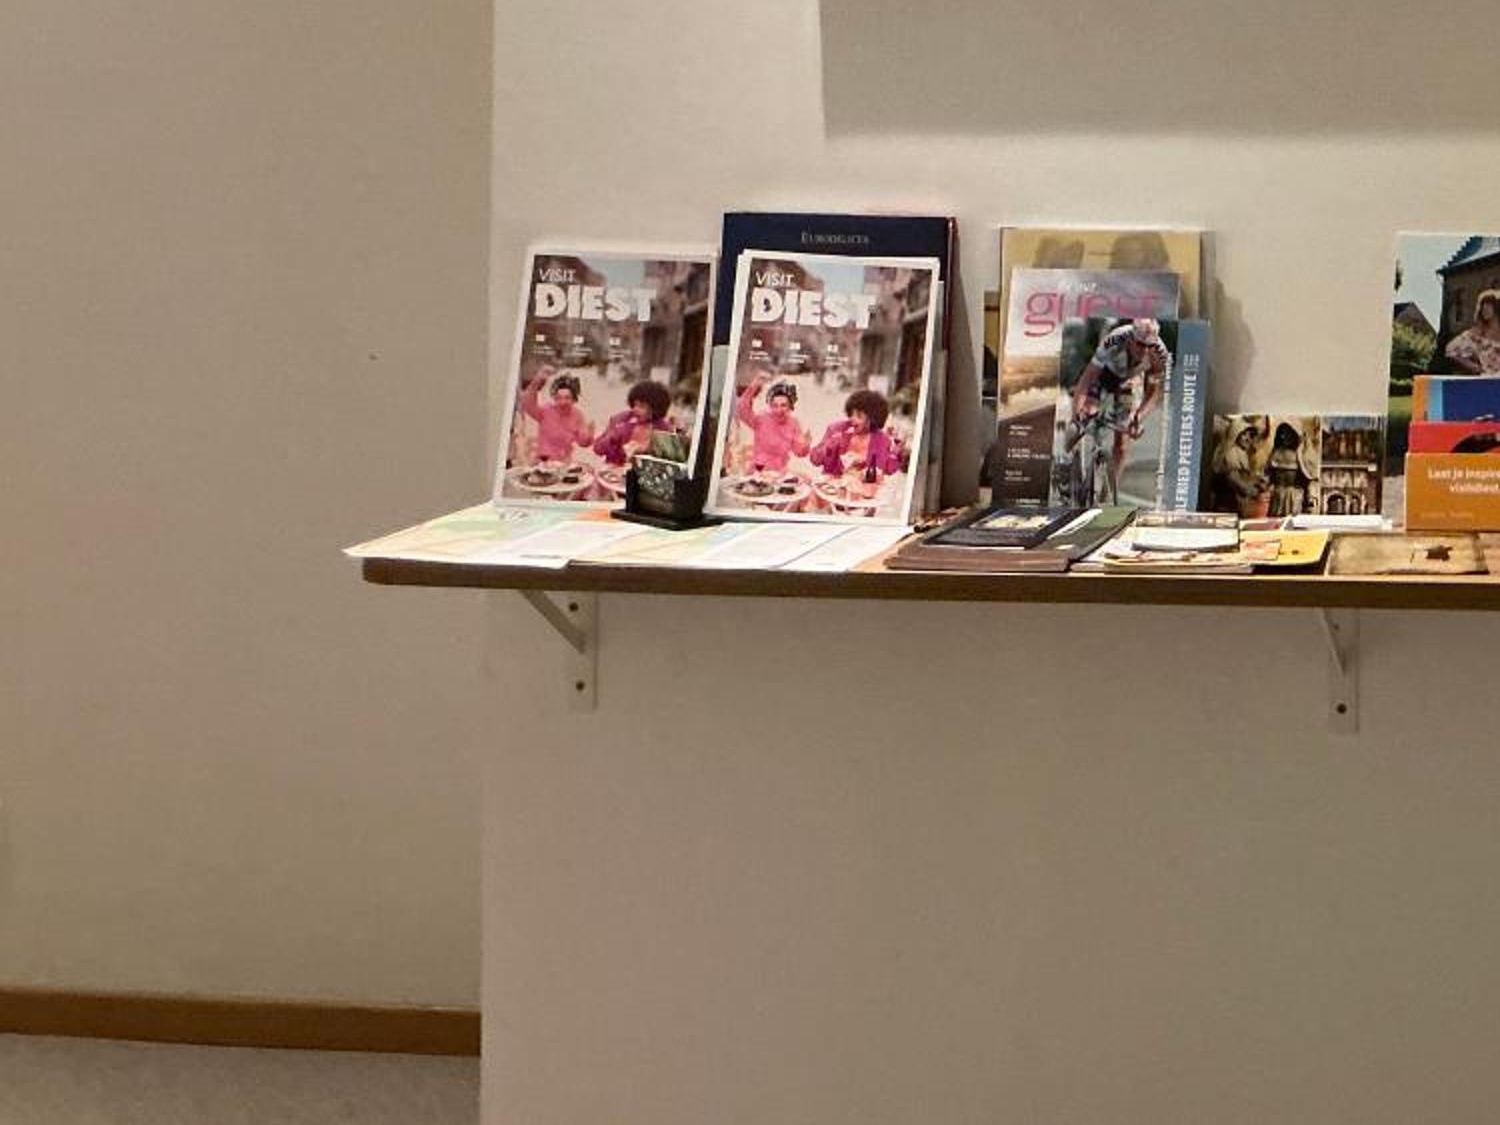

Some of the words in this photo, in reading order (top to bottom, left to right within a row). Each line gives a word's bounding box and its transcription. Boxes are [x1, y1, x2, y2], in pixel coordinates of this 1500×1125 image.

[539, 268, 577, 282] VISIT
[755, 272, 795, 286] VISIT
[535, 283, 657, 322] DIEST
[751, 287, 878, 329] DIEST
[1182, 373, 1197, 412] ROUTE
[1178, 413, 1194, 465] PEETERS
